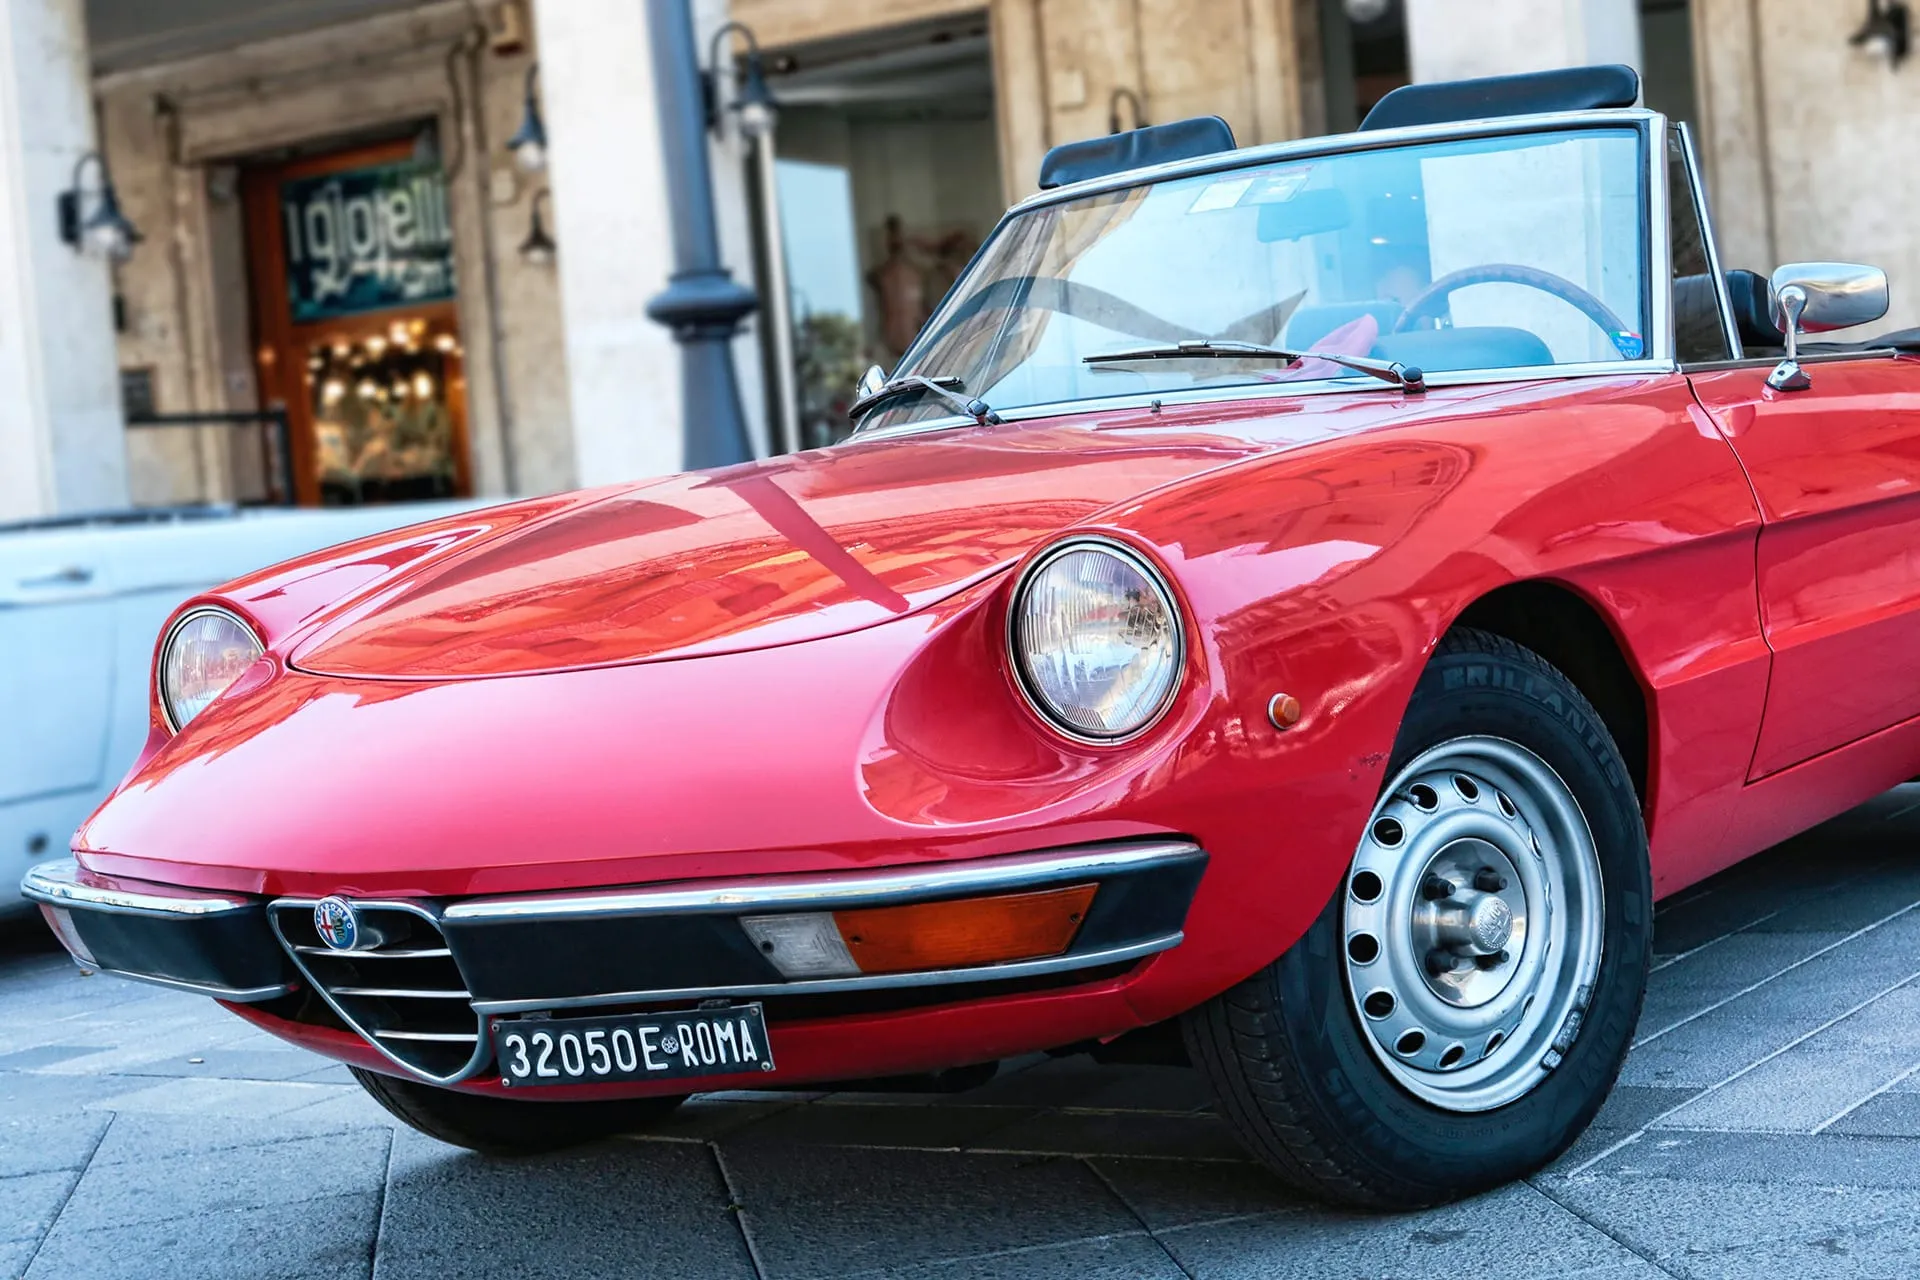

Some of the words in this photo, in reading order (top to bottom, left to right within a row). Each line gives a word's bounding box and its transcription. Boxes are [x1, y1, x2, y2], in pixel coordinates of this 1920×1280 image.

[1442, 665, 1624, 790] BRILLANTIS
[505, 1026, 669, 1078] 32050E
[677, 1019, 758, 1068] ROMA
